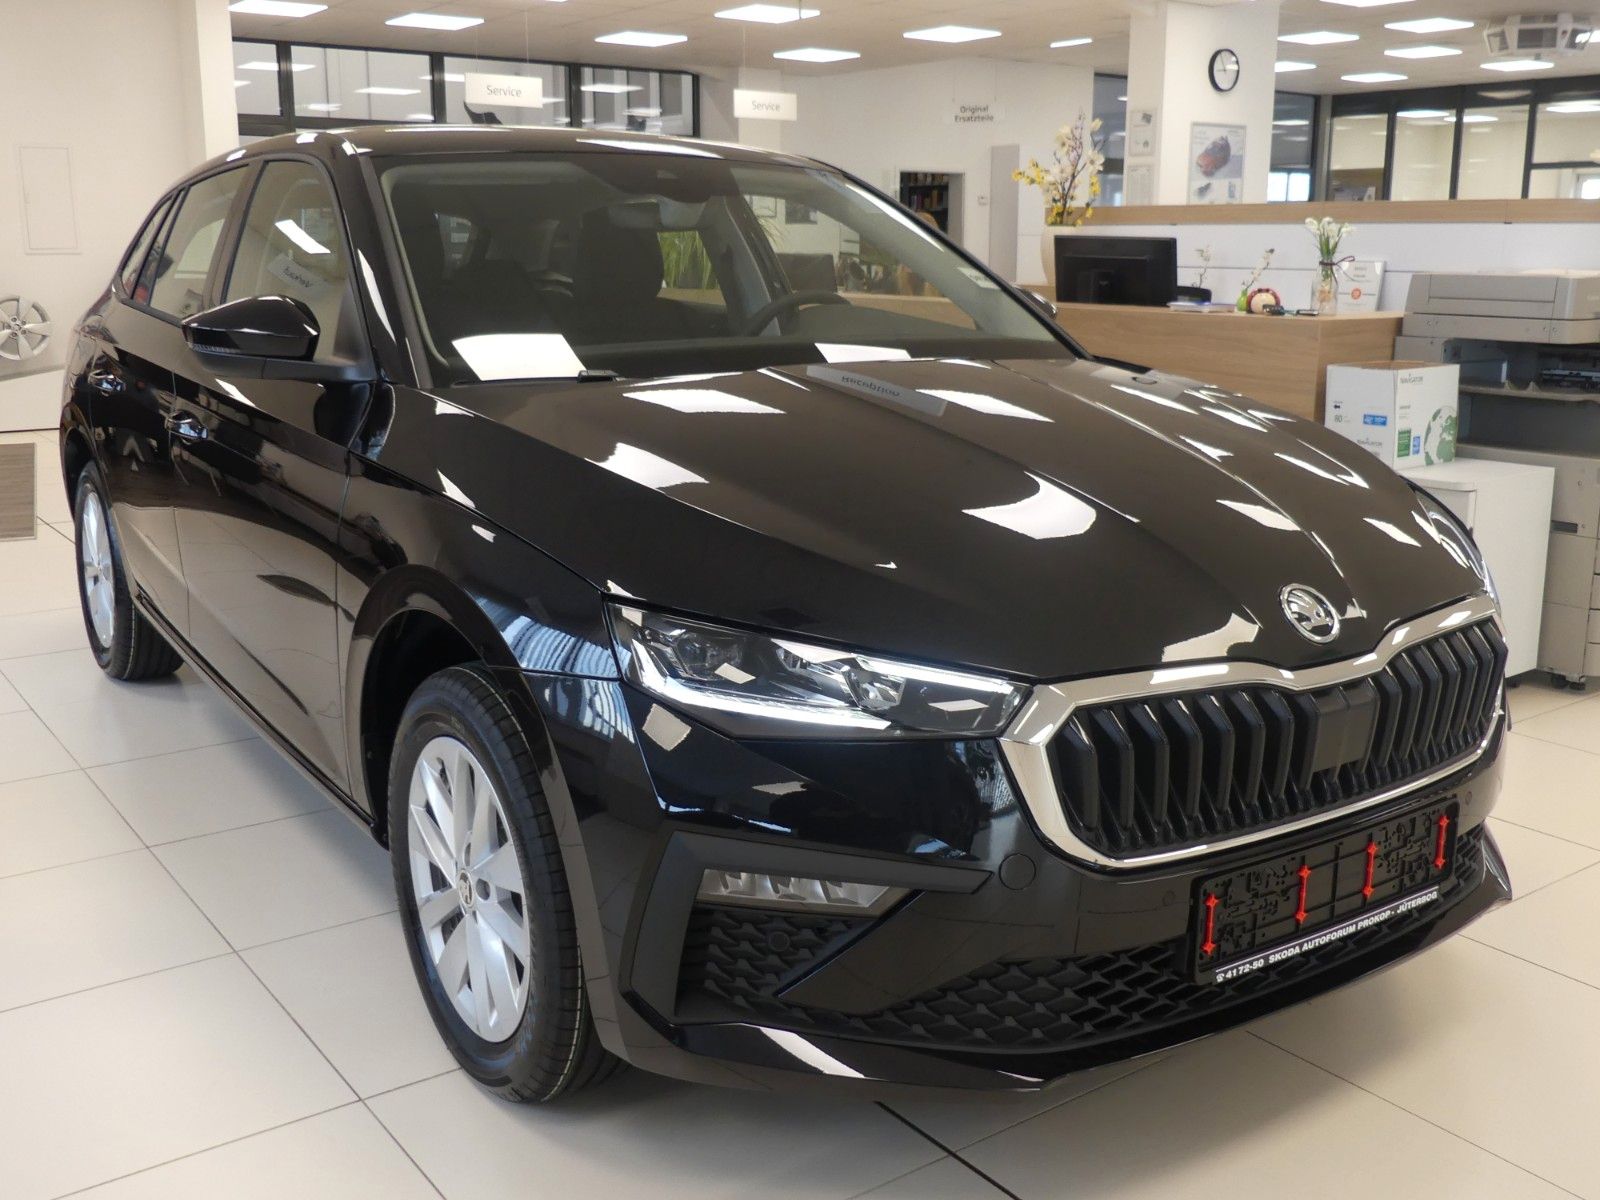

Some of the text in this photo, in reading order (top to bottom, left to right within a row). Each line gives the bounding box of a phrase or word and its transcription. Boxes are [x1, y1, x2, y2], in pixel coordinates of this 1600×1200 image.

[486, 84, 522, 98] Service
[751, 99, 781, 112] Service
[960, 104, 989, 114] Original
[954, 114, 994, 122] Ersatzteile
[1268, 945, 1301, 964] SKODA
[1301, 923, 1357, 952] AUTOFORUM
[1397, 890, 1438, 914] JÜTERBOG
